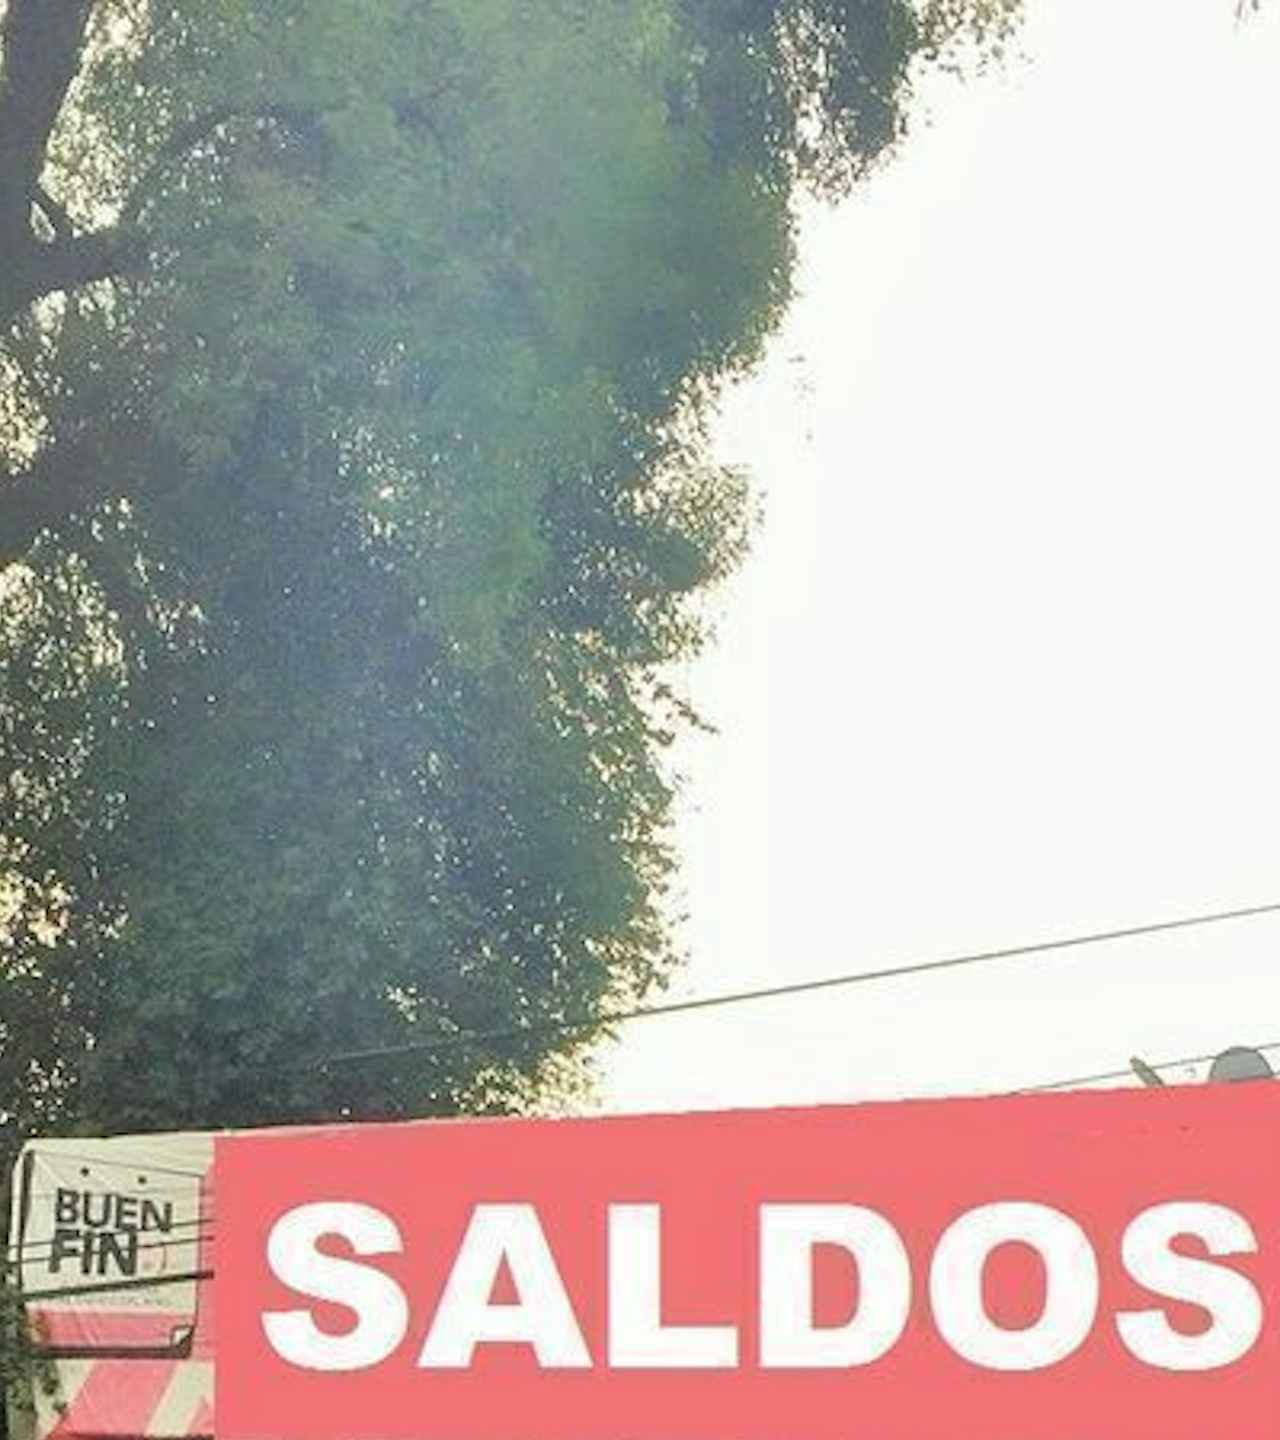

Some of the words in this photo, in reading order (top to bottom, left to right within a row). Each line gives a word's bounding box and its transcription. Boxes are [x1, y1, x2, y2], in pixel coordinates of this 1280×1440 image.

[55, 1187, 173, 1232] BUEN
[48, 1228, 138, 1276] FIN
[261, 1201, 1263, 1371] SALDOS
